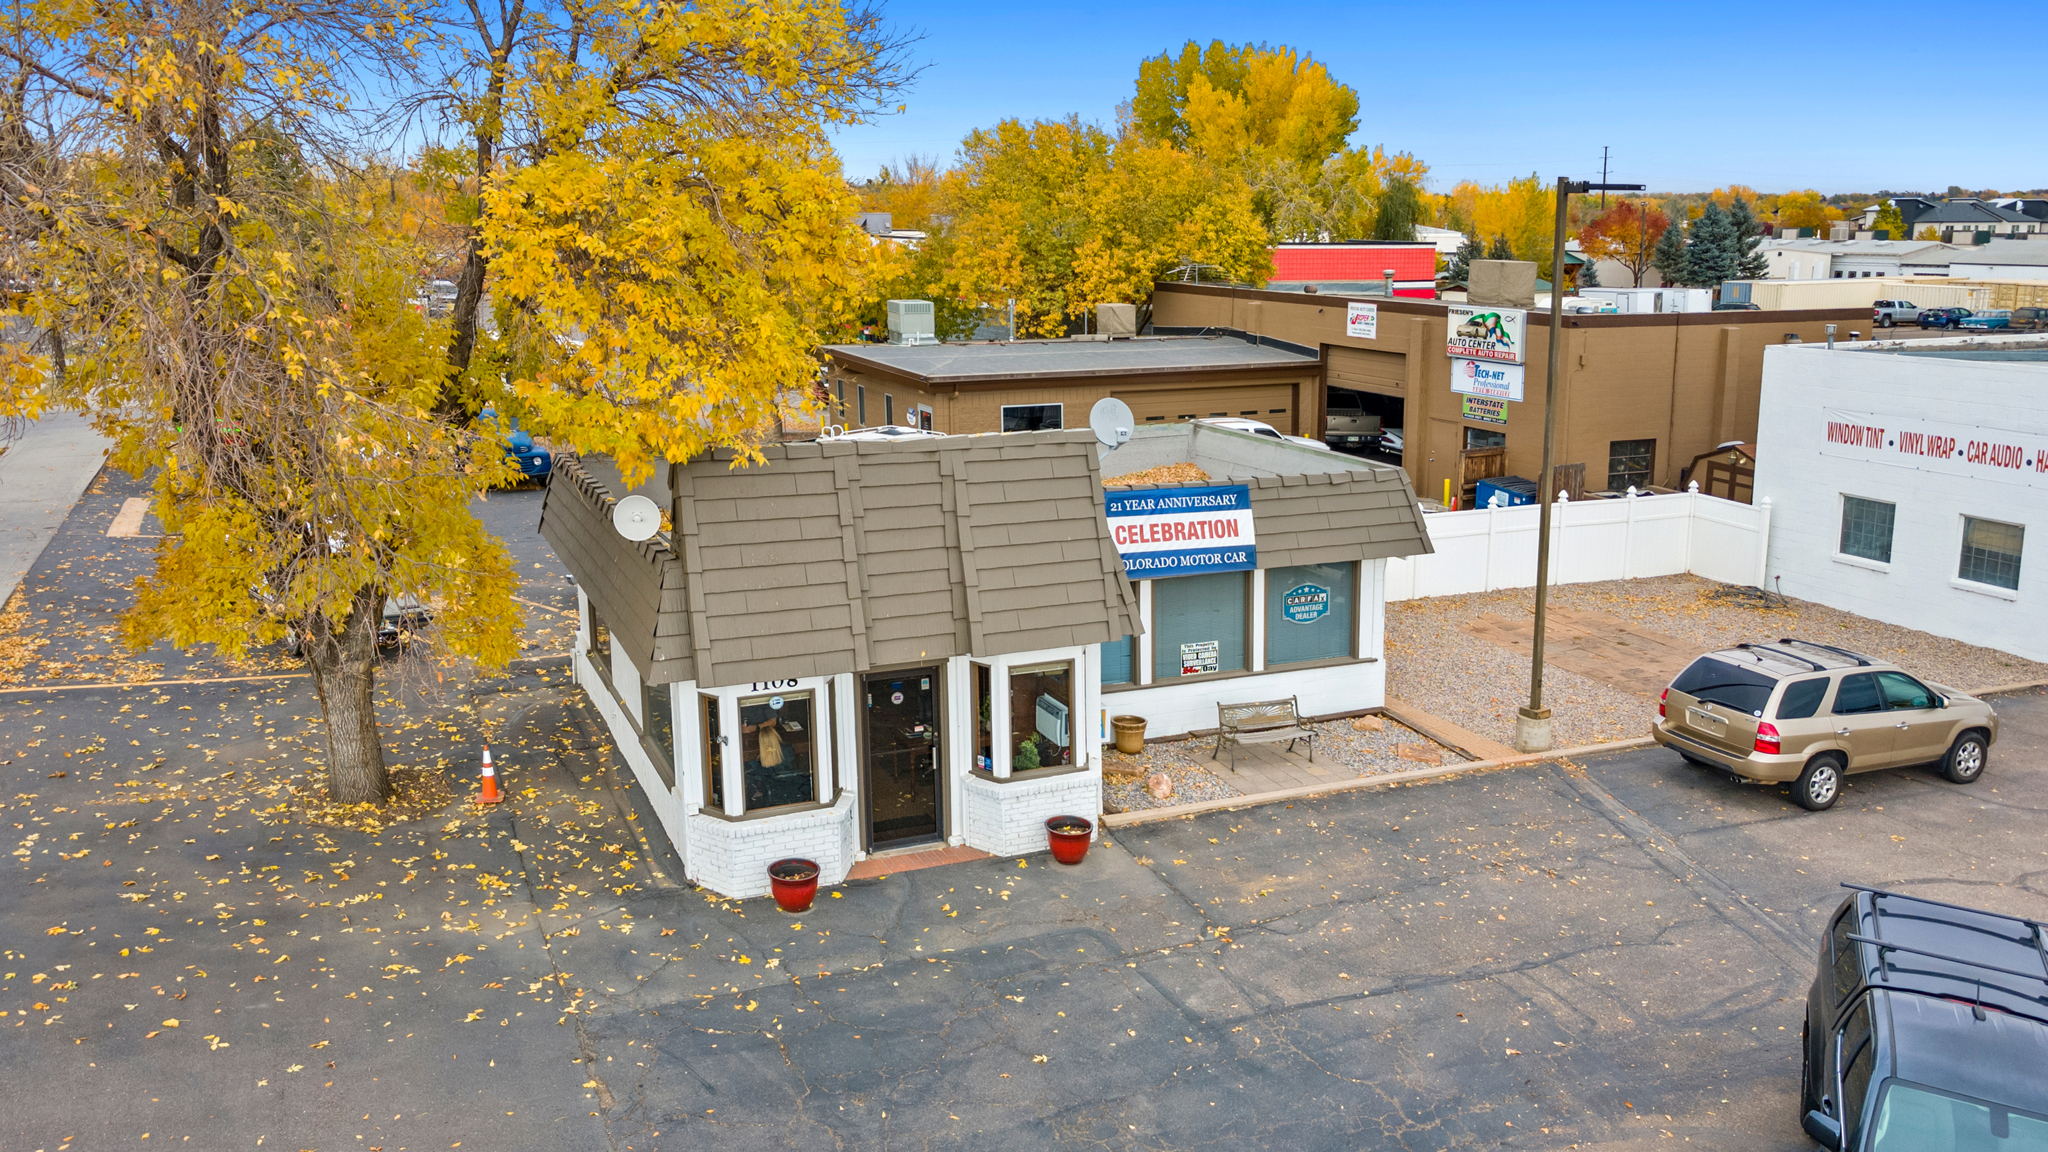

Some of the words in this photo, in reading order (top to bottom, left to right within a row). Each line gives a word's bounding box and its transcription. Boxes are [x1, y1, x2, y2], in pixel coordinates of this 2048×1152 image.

[1448, 308, 1474, 316] FRIESEN'S
[1448, 337, 1467, 347] AUTO
[1468, 339, 1496, 350] CENTER
[1447, 346, 1476, 356] COMPLETE
[1477, 350, 1494, 358] AUTO
[1494, 351, 1516, 360] REPAIR
[1473, 377, 1510, 390] Professional
[1466, 397, 1505, 409] INTERSTATE
[1468, 407, 1501, 417] BATTERIES
[1827, 421, 1865, 446] WINDOW
[1866, 426, 1885, 450] TINT
[1899, 431, 1924, 456] VINYL
[1927, 435, 1956, 459] WRAP
[1967, 440, 1989, 463] CAR
[1989, 444, 2023, 470] AUDIO
[1110, 501, 1123, 512] 21
[1124, 499, 1156, 511] YEAR
[1157, 494, 1237, 509] ANNIVERSARY
[1115, 518, 1239, 545] CELEBRATION
[1121, 556, 1178, 571] OLORADO
[1180, 553, 1222, 567] MOTOR
[1224, 551, 1247, 564] CAR
[1286, 592, 1327, 605] CARFAX
[1289, 604, 1324, 614] ADVANTAGE
[1295, 612, 1318, 620] DEALER
